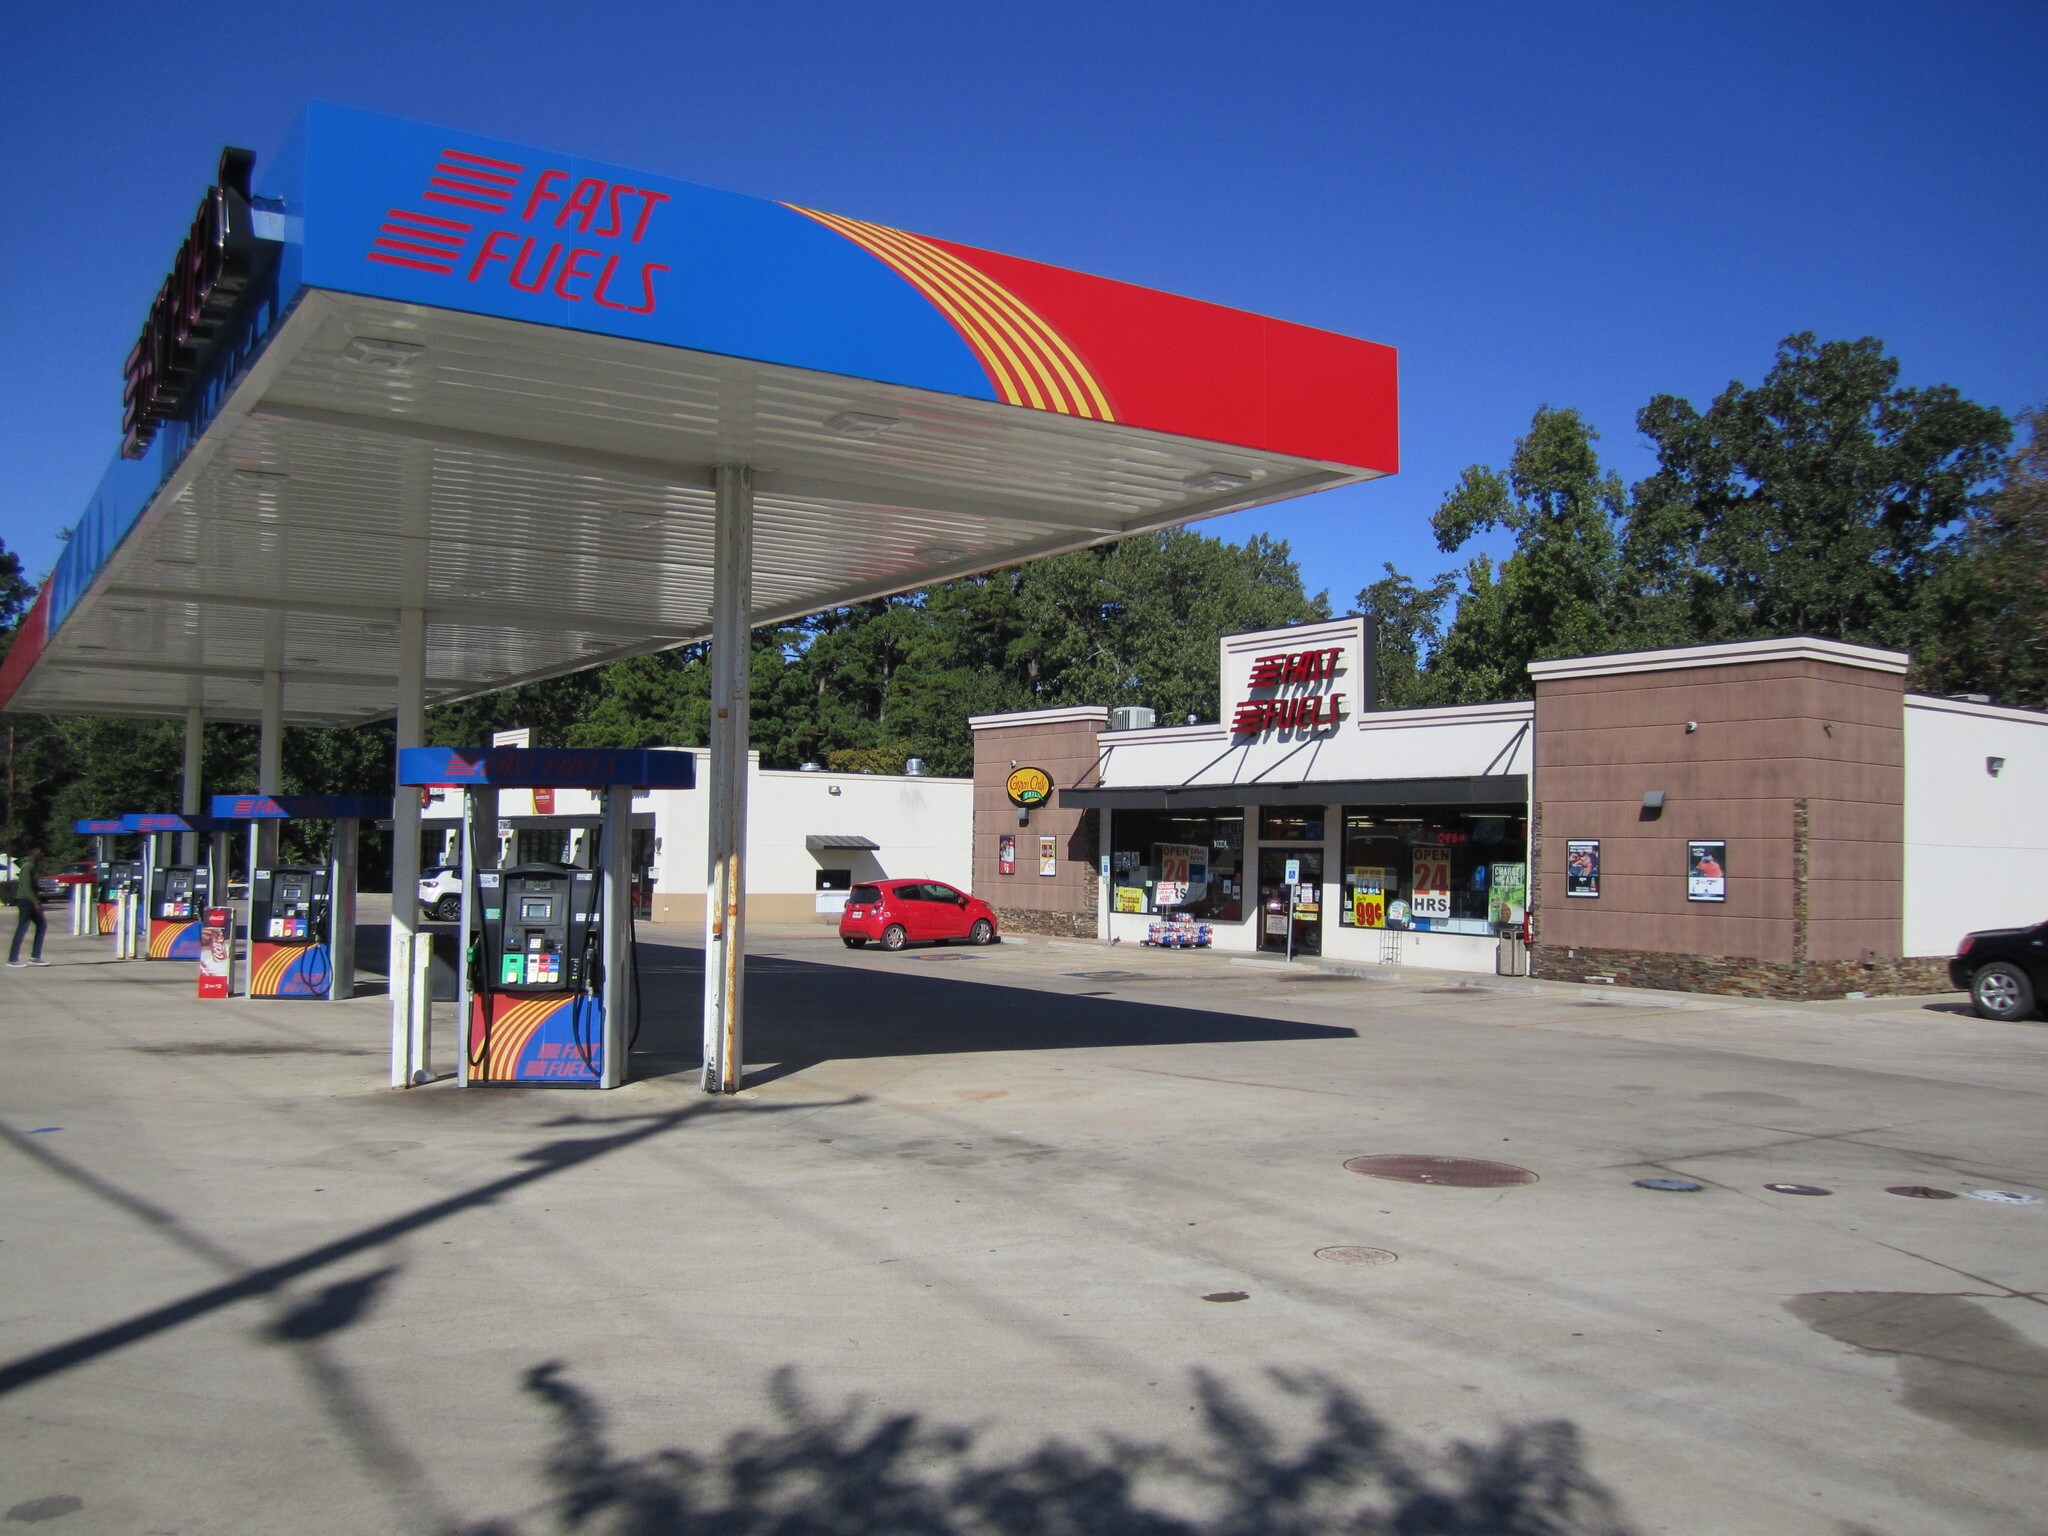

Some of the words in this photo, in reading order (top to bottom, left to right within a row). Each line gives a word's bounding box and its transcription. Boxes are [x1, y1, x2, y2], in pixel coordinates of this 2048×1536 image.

[522, 169, 672, 244] FAST
[467, 230, 672, 315] FUELS
[1280, 647, 1345, 684] FAST
[1263, 693, 1347, 730] FUELS
[1164, 846, 1188, 856] OPEN
[1414, 849, 1450, 860] OPEN
[1163, 858, 1189, 885] 24
[1414, 863, 1449, 896] 24
[1356, 902, 1383, 926] 99¢
[1414, 898, 1447, 912] HRS
